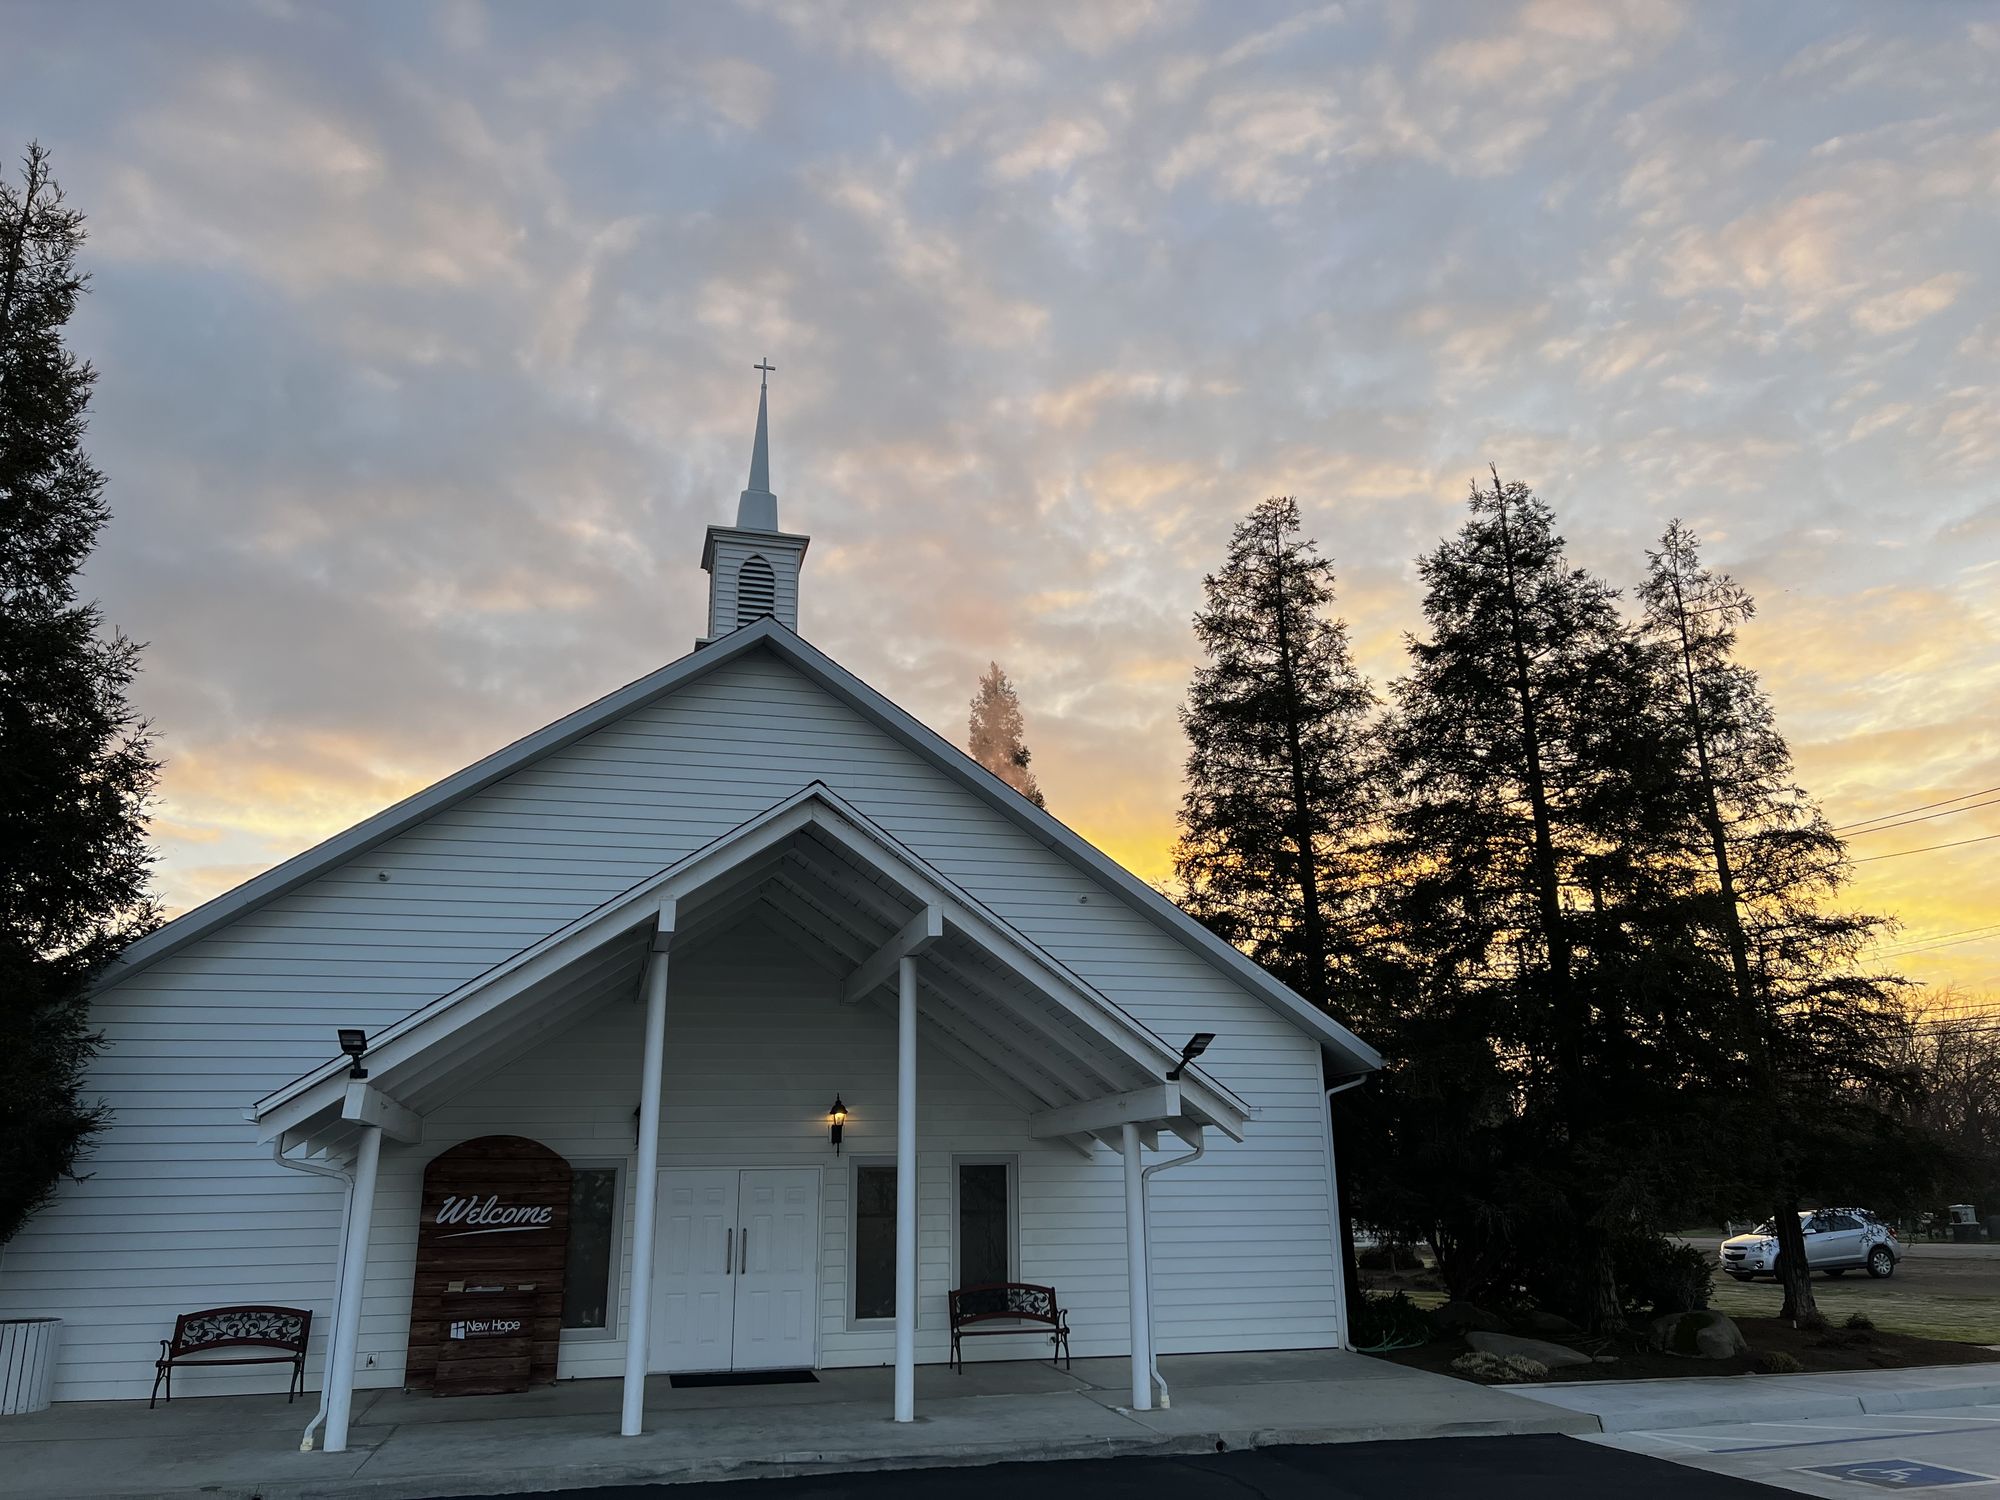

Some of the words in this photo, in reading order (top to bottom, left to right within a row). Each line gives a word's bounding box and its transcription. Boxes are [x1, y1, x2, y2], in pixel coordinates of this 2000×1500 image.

[436, 1195, 552, 1224] Welcome
[466, 1319, 490, 1332] New
[492, 1319, 521, 1333] Hope
